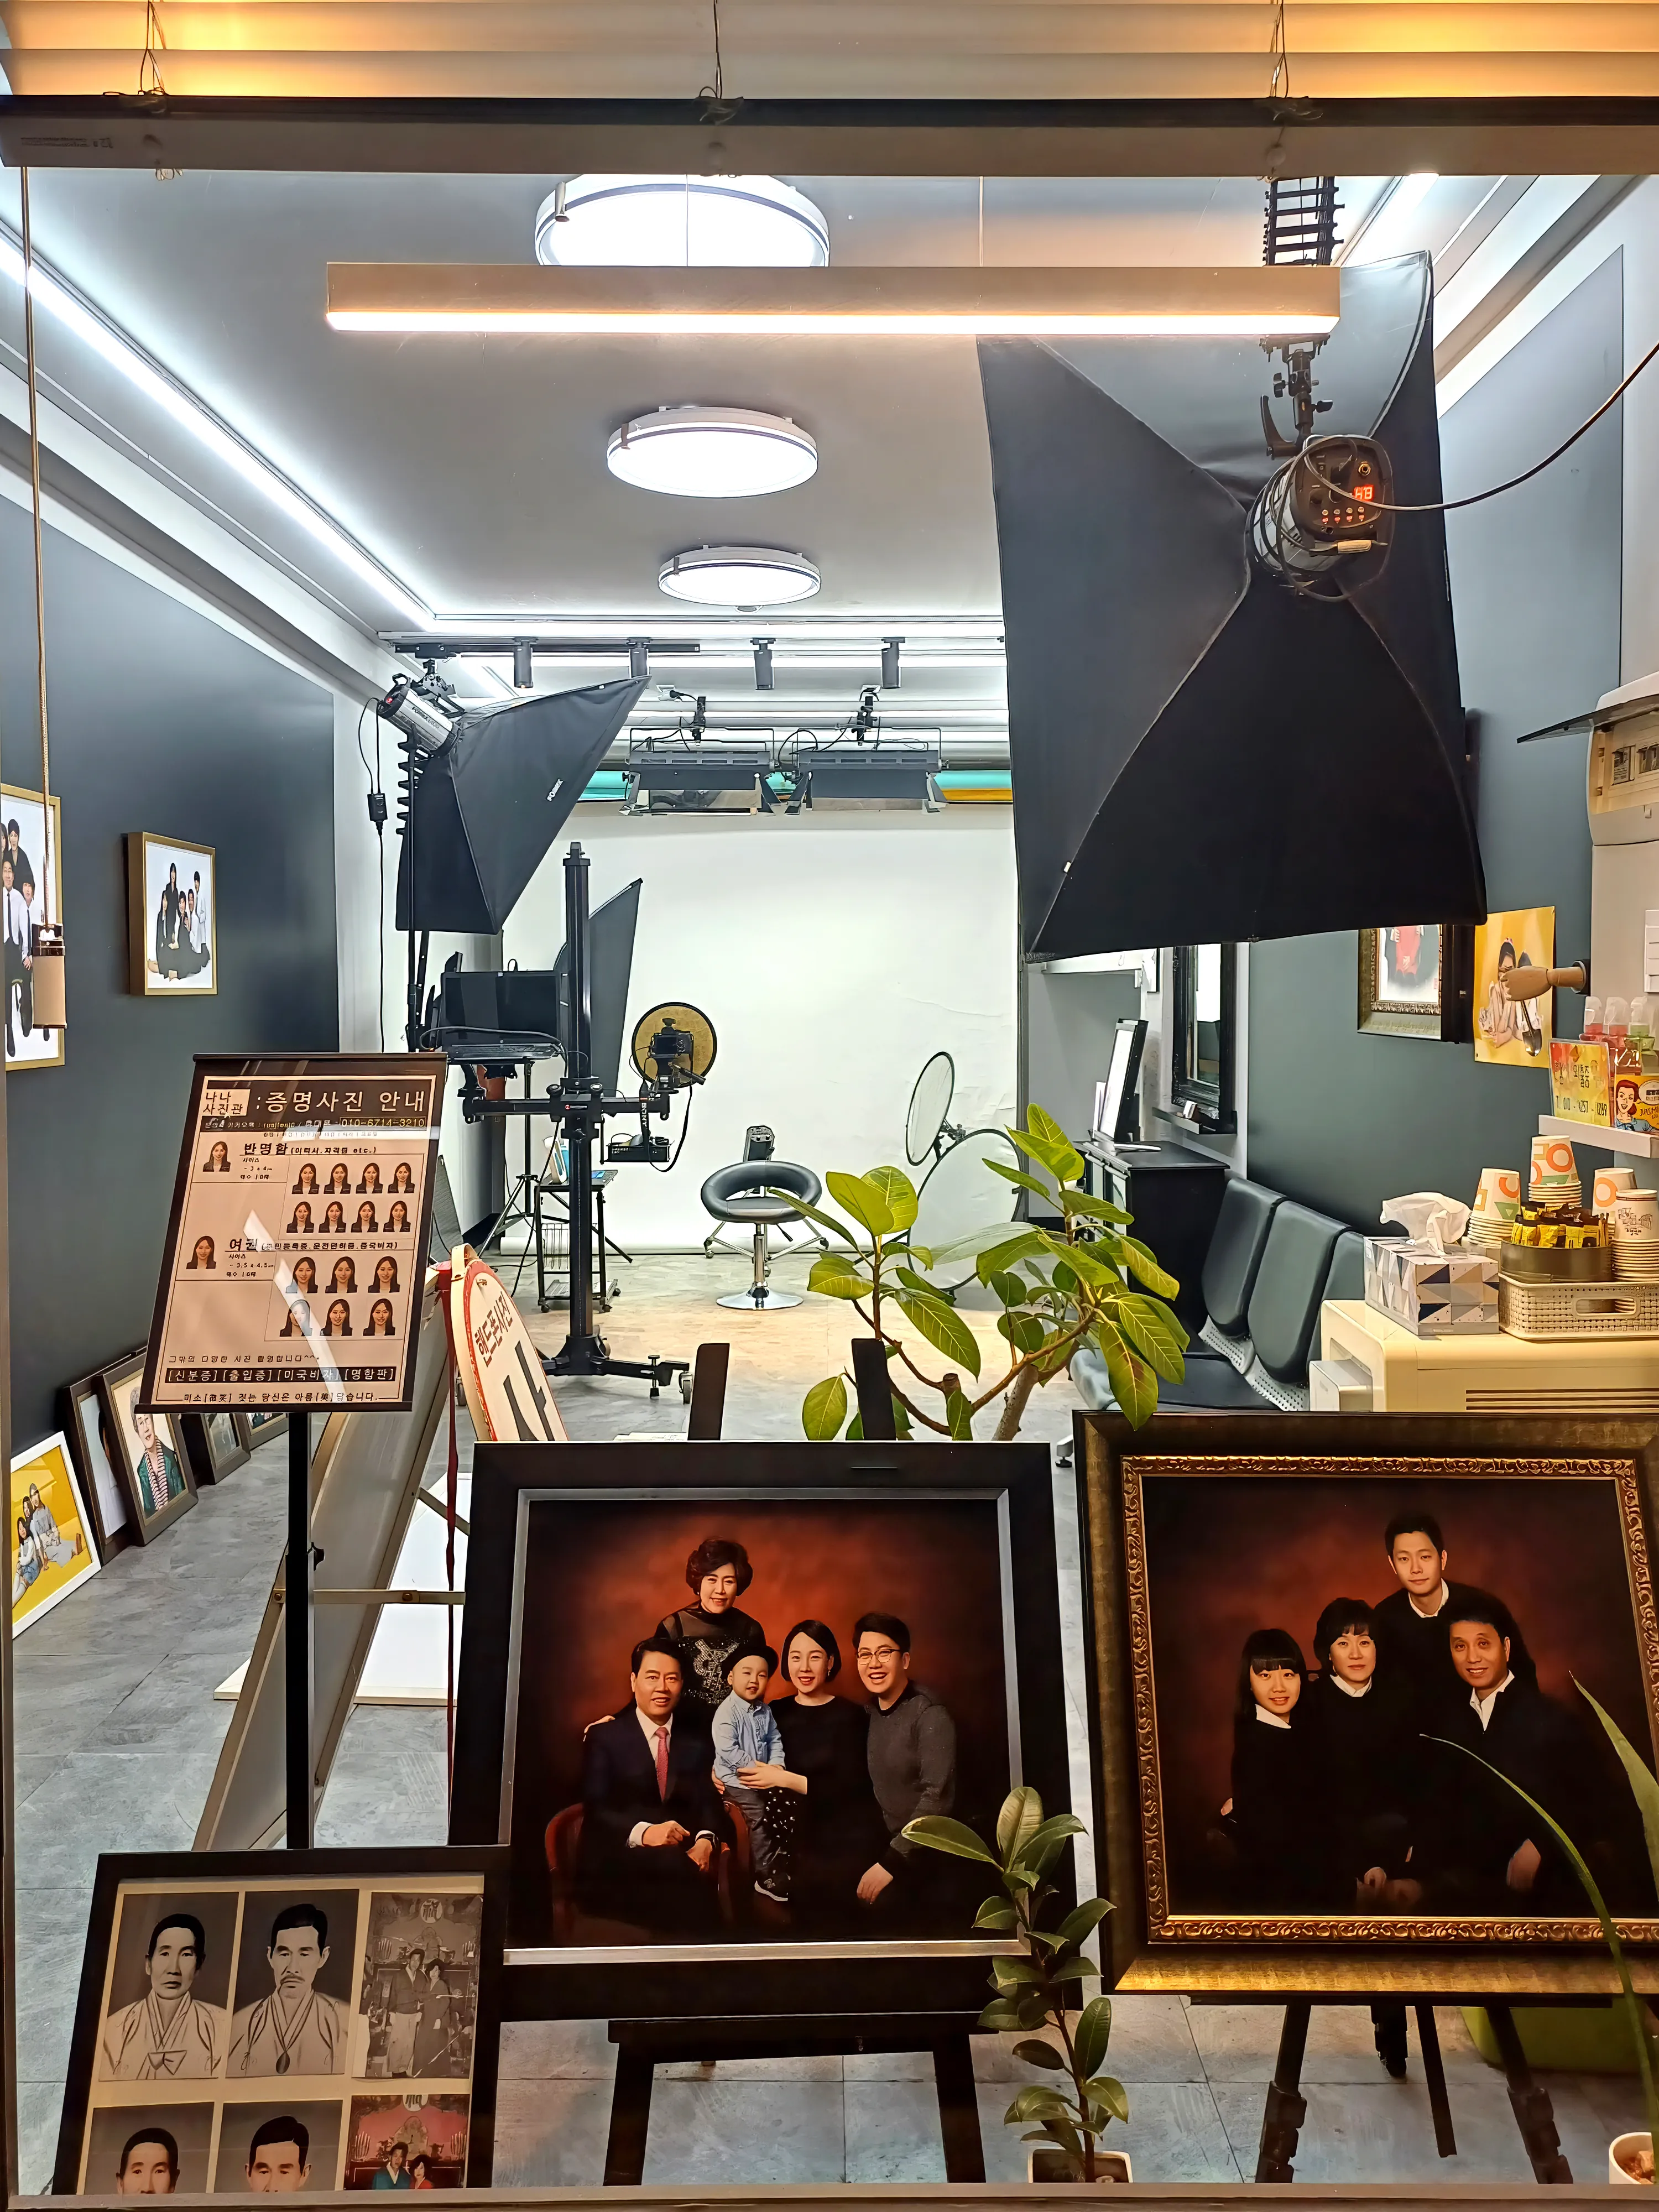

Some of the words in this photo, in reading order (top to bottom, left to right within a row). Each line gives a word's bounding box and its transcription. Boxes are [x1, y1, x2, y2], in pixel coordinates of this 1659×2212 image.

[206, 1091, 231, 1103] 나나
[265, 1091, 363, 1113] 증명사진
[379, 1091, 424, 1112] 안내
[203, 1104, 243, 1115] 사진관
[244, 1143, 288, 1155] 반명함
